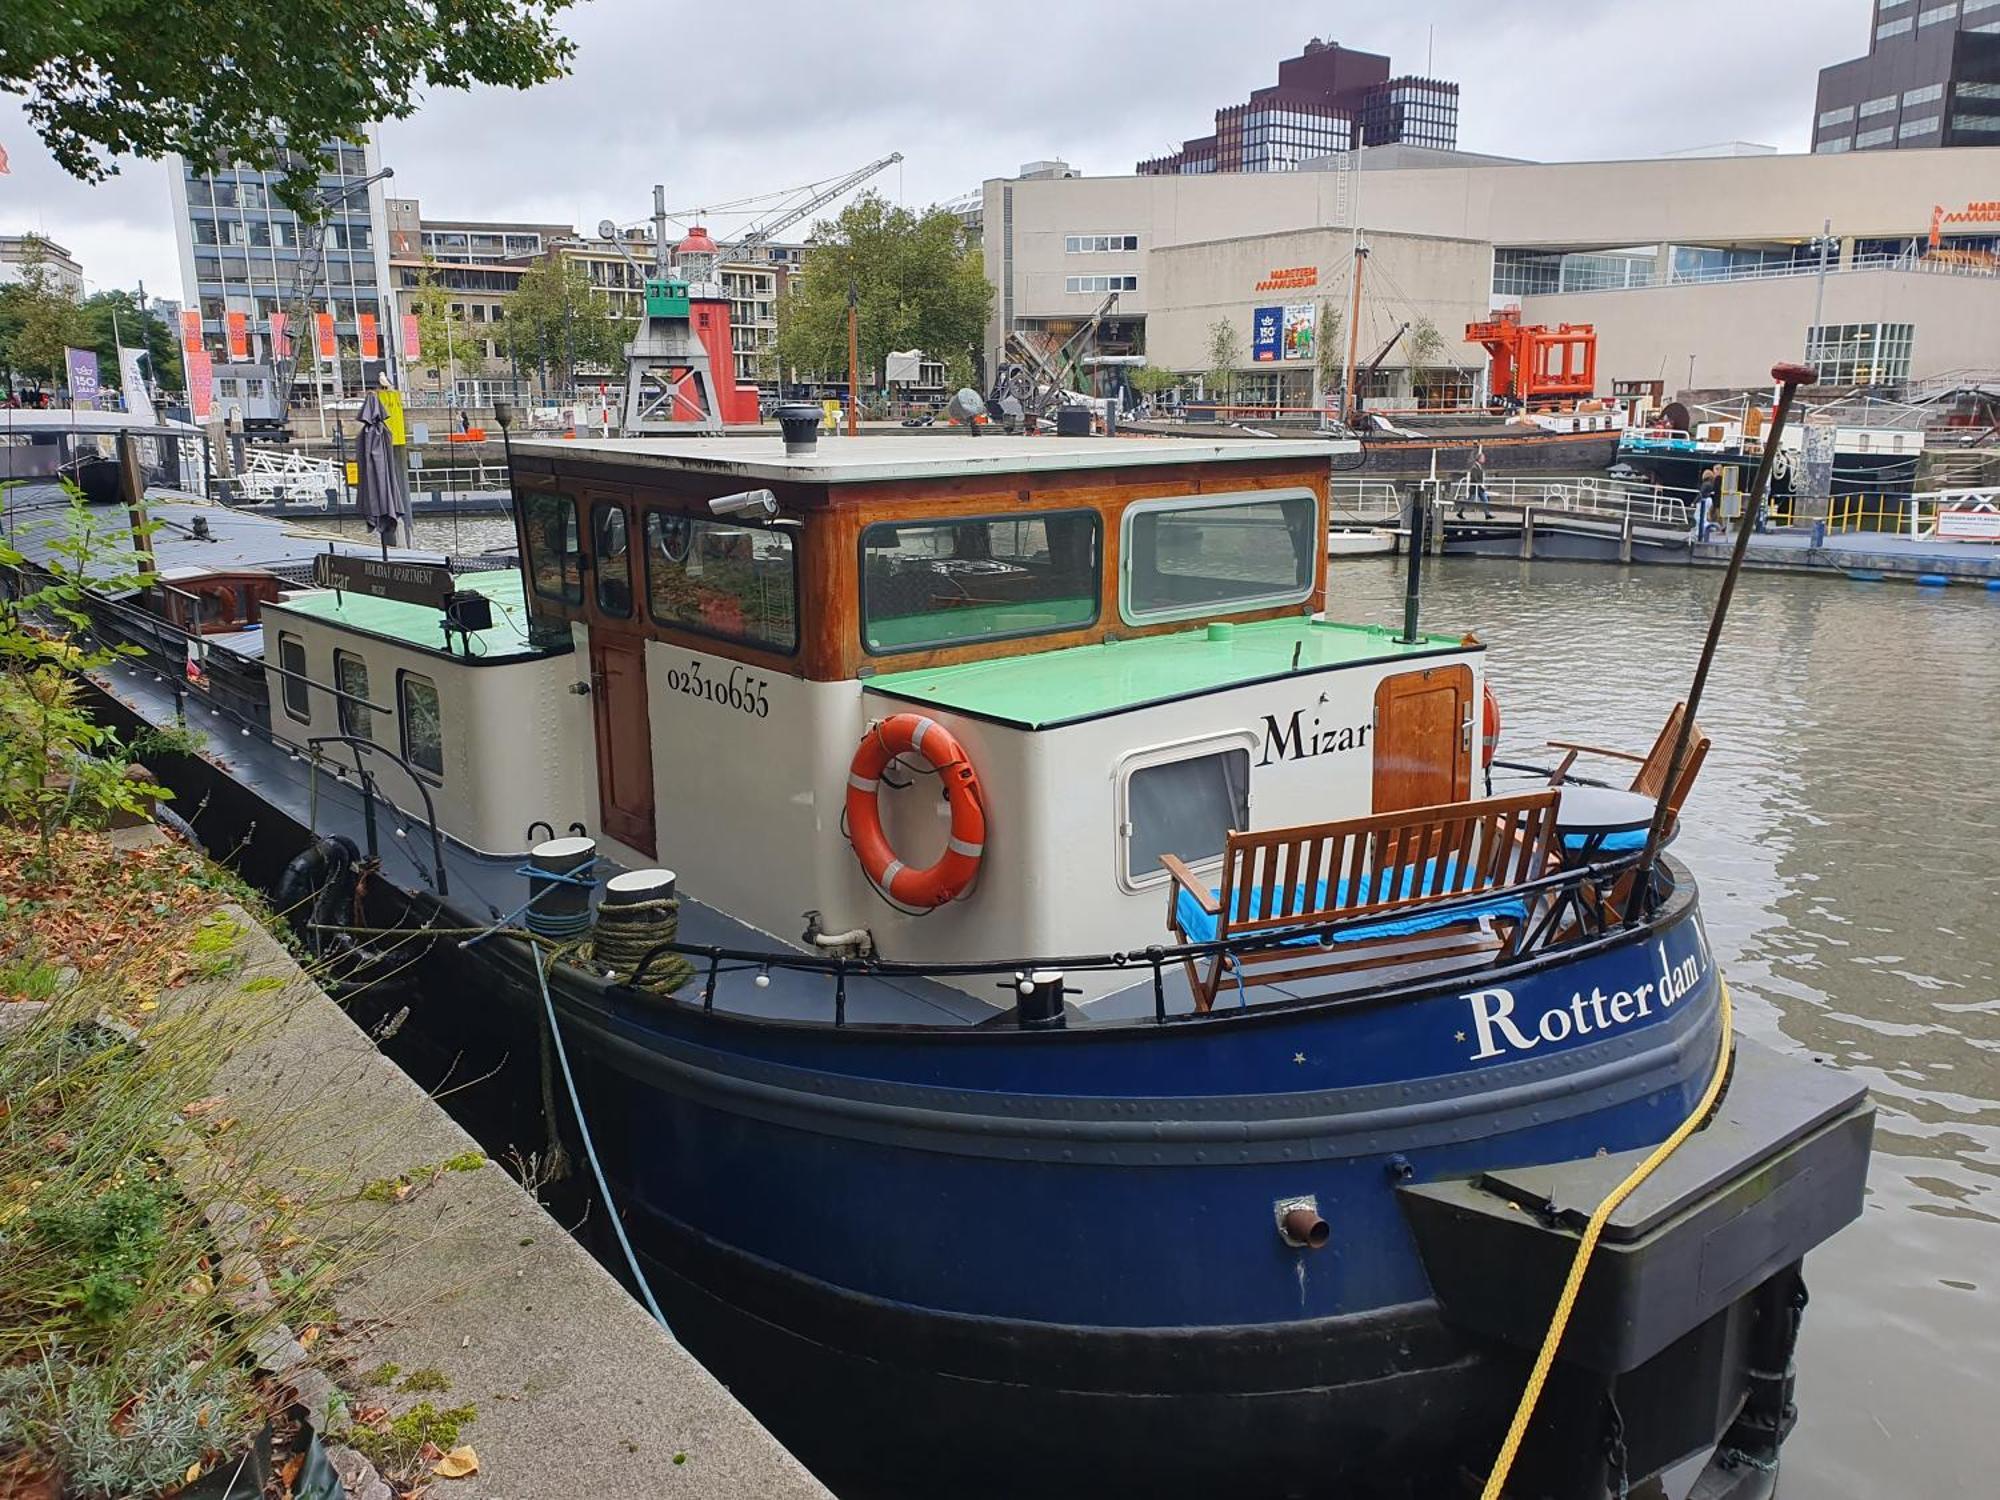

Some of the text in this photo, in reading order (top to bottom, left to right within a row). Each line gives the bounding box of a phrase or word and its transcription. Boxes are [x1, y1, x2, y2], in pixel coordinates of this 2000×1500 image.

[1260, 327, 1275, 337] 150
[74, 375, 96, 386] 150
[318, 555, 350, 590] Mizar
[364, 561, 391, 579] HOLIDAY
[393, 566, 433, 585] APARTMENT
[667, 661, 769, 718] 02310655
[1254, 708, 1371, 768] Mizar
